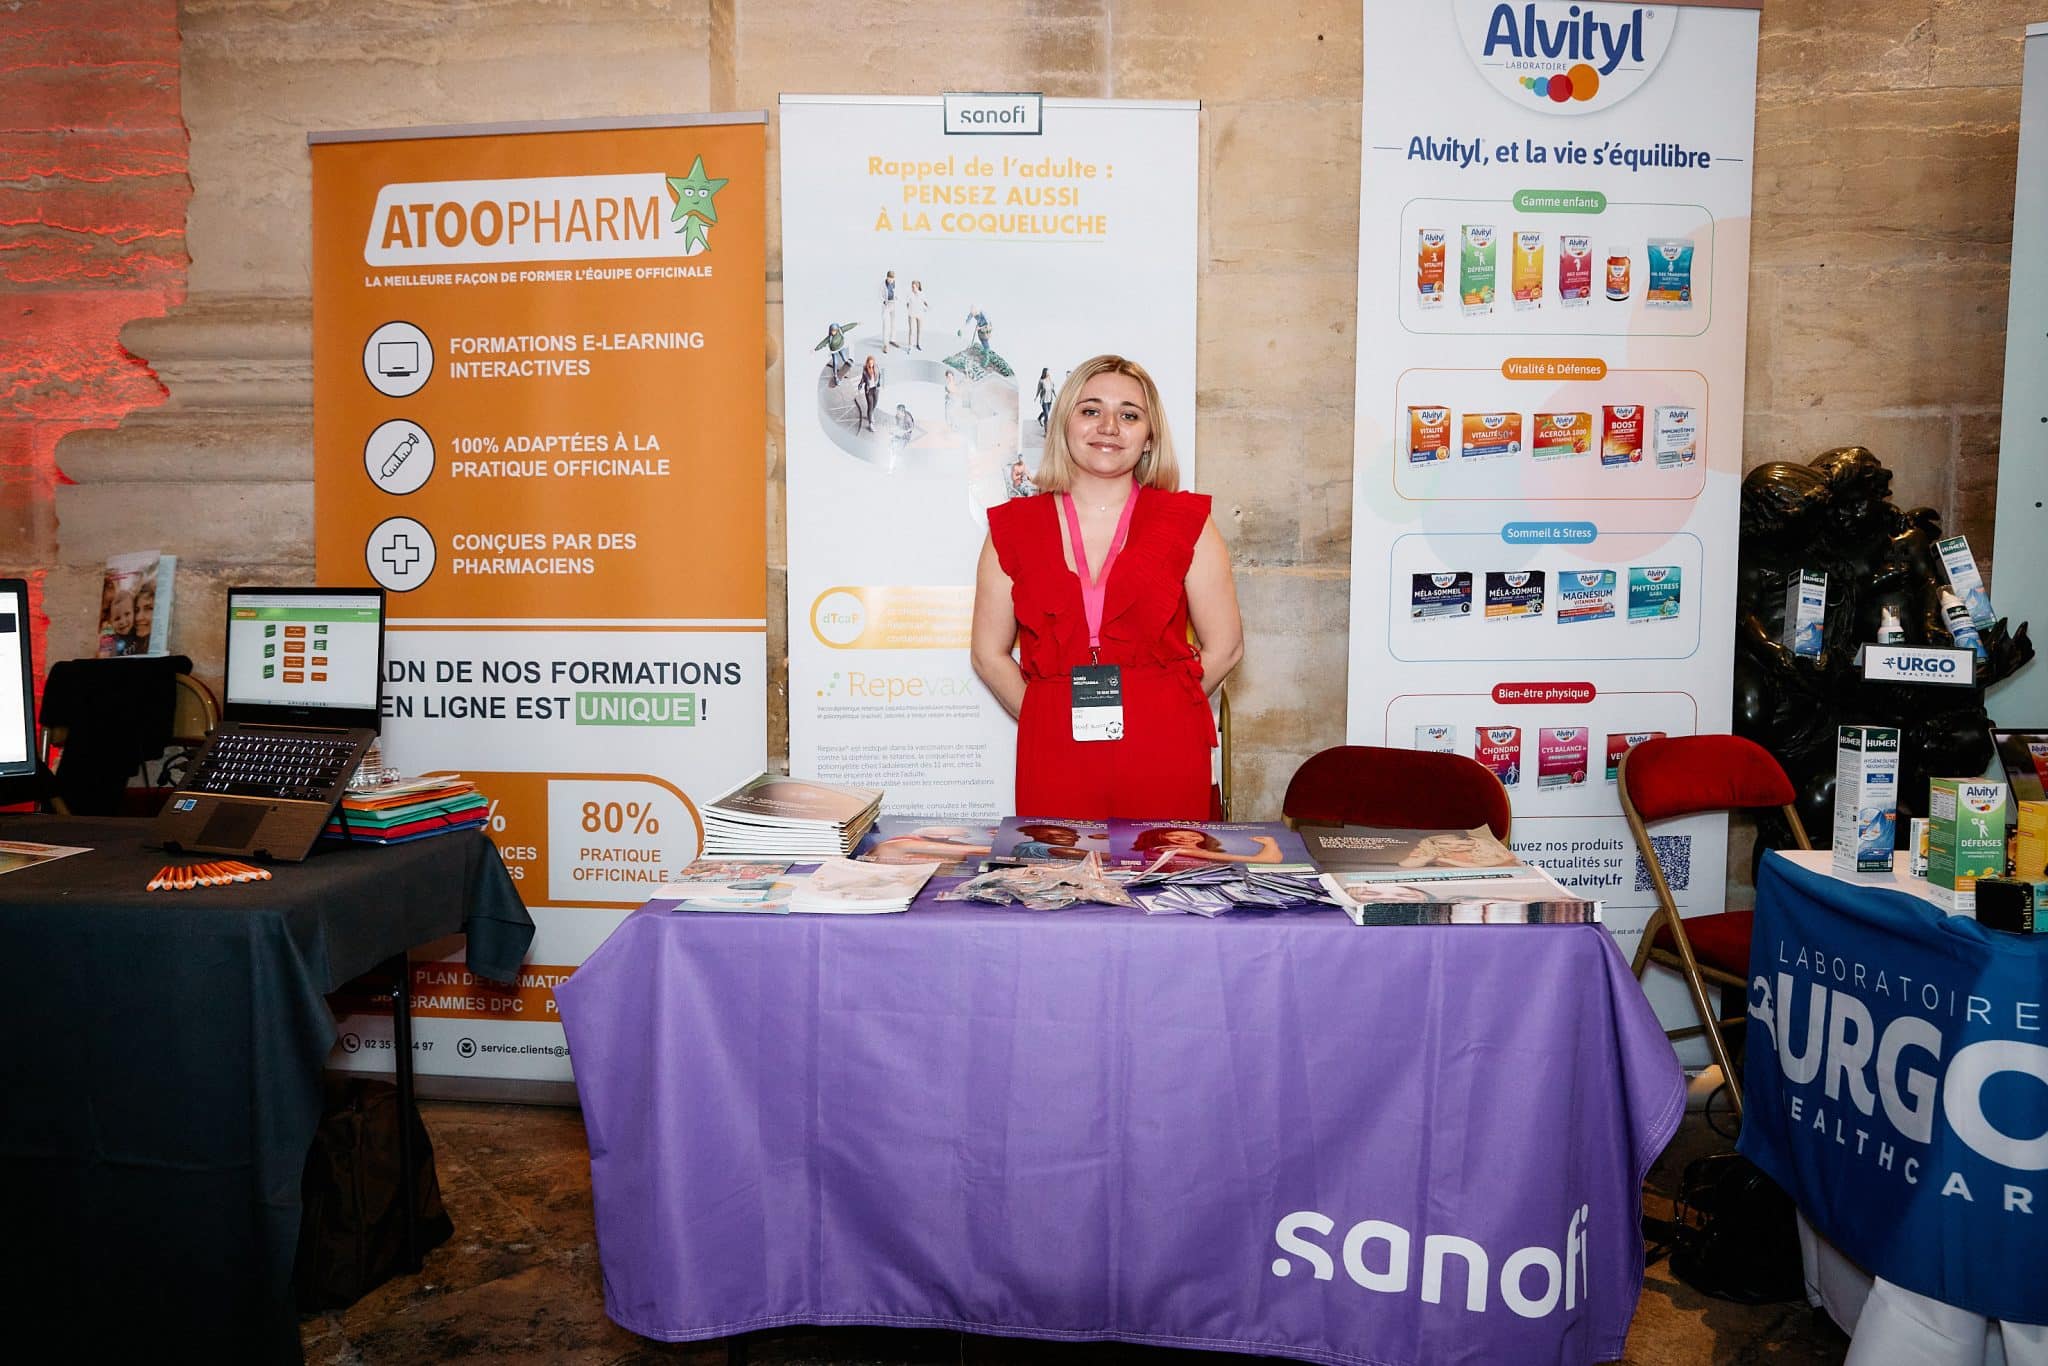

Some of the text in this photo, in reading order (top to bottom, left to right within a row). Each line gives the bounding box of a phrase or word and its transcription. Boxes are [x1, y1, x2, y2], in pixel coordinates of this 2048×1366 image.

[1505, 61, 1568, 71] LABORATOIRE
[960, 106, 1025, 124] sanofi
[1495, 142, 1519, 164] et
[1525, 138, 1547, 164] la
[1553, 141, 1587, 165] vie
[1593, 141, 1711, 172] s'équilibre
[868, 154, 954, 181] Rappel
[964, 155, 993, 177] de
[1002, 156, 1097, 179] l'adulte
[903, 184, 1079, 207] PENSEZ AUSSI
[1521, 196, 1599, 208] Gamme enfants
[381, 195, 660, 250] ATOOPHARM
[875, 206, 1107, 235] À LA COQUELUCHE
[1471, 228, 1492, 237] Alvityl
[365, 266, 713, 287] LA MEILLEURE FAÇON DE FORMER L'ÉQUIPE OFFICINALE
[450, 332, 704, 354] FORMATIONS E-LEARNING
[450, 360, 591, 378] INTERACTIVES
[1508, 363, 1601, 374] Vitalité & Défenses
[1422, 410, 1443, 420] Alvityl
[1669, 410, 1689, 419] Alvityl
[1611, 420, 1637, 430] BOOST
[1471, 430, 1498, 439] VITALITÉ
[1539, 430, 1571, 439] ACEROLA
[451, 430, 660, 454] 100% ADAPTÉES À LA
[451, 459, 670, 478] PRATIQUE OFFICINALE
[1507, 527, 1592, 538] Sommeil & Stress
[452, 533, 637, 553] CONÇUES PAR DES
[452, 558, 595, 575] PHARMACIENS
[1647, 569, 1666, 578] Alvityl
[1414, 587, 1462, 598] MÉLA-SOMMEIL
[1489, 586, 1543, 598] MÉLA-SOMMEIL
[1562, 588, 1613, 601] MAGNÉSIUM
[1631, 582, 1680, 593] PHYTOSTRESS
[1896, 656, 1956, 673] URGO
[436, 661, 472, 683] DE
[482, 661, 541, 684] NOS
[551, 661, 742, 685] FORMATIONS
[847, 671, 973, 704] Repevax
[1498, 688, 1590, 700] Bien-être physique
[382, 696, 707, 723] EN LIGNE EST UNIQUE !
[1428, 727, 1448, 736] Alvityl
[1491, 731, 1512, 740] Alvityl
[1556, 730, 1575, 738] Alvityl
[1839, 736, 1861, 746] HUMER
[1866, 738, 1897, 748] HUMER
[1482, 745, 1519, 755] CHONDRO
[1492, 753, 1510, 761] FLEX
[1966, 786, 1998, 797] Alvityl
[581, 801, 660, 835] 80%
[1545, 841, 1568, 852] nos
[1571, 838, 1624, 854] produits
[1961, 838, 2002, 848] DÉFENSES
[580, 848, 661, 863] PRATIQUE
[1538, 856, 1601, 869] actualités
[1603, 858, 1624, 868] sur
[573, 867, 669, 883] OFFICINALE
[1554, 873, 1624, 889] w.alvityl.fr
[416, 970, 458, 986] PLAN
[490, 997, 524, 1013] DPC
[365, 1039, 377, 1049] 02
[379, 1040, 391, 1049] 35
[422, 1042, 434, 1051] 97
[481, 1043, 570, 1058] service.clients@a
[1777, 971, 2048, 1171] URGO
[1271, 1203, 1589, 1318] sanofi
